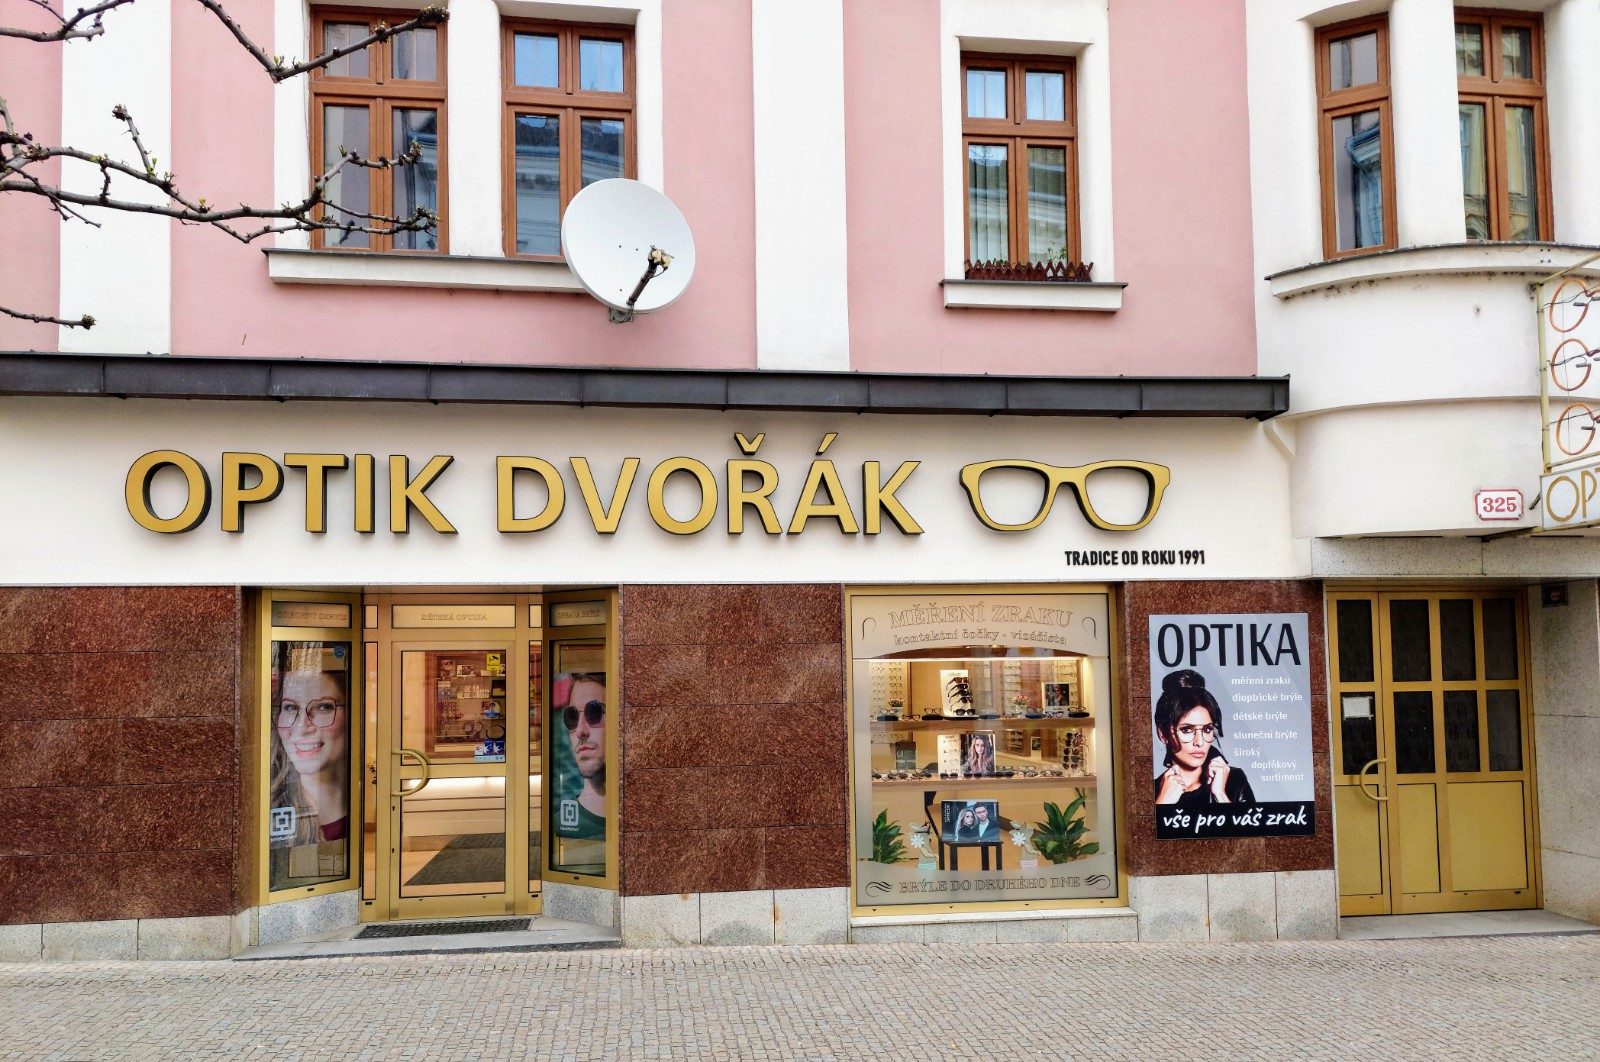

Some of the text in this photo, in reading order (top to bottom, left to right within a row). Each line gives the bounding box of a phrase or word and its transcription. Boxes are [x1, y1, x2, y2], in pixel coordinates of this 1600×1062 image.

[124, 432, 925, 536] OPTIK DVOŘÁK
[1546, 467, 1600, 523] OP
[1482, 496, 1518, 513] 325
[1064, 550, 1205, 566] TRADICE OD ROKU 1991
[421, 611, 488, 621] DĚTSKÁ OPTIKA
[889, 601, 1074, 629] MĚŘENÍ ZRAKU
[894, 628, 1067, 645] kontaktní čočky vizážista
[1157, 622, 1302, 668] OPTIKA
[1231, 675, 1291, 685] měření zraku
[1232, 691, 1303, 704] dioptrické brýle
[1232, 711, 1288, 722] dětské brýle
[1233, 729, 1298, 741] sluneční brýle
[1234, 747, 1261, 758] široký
[1251, 759, 1297, 771] doplňkový
[1261, 772, 1305, 782] sortiment
[1163, 805, 1308, 834] vše pro váš zrak
[899, 876, 1081, 894] BRÝLE DO DRUHÉHO DNE
